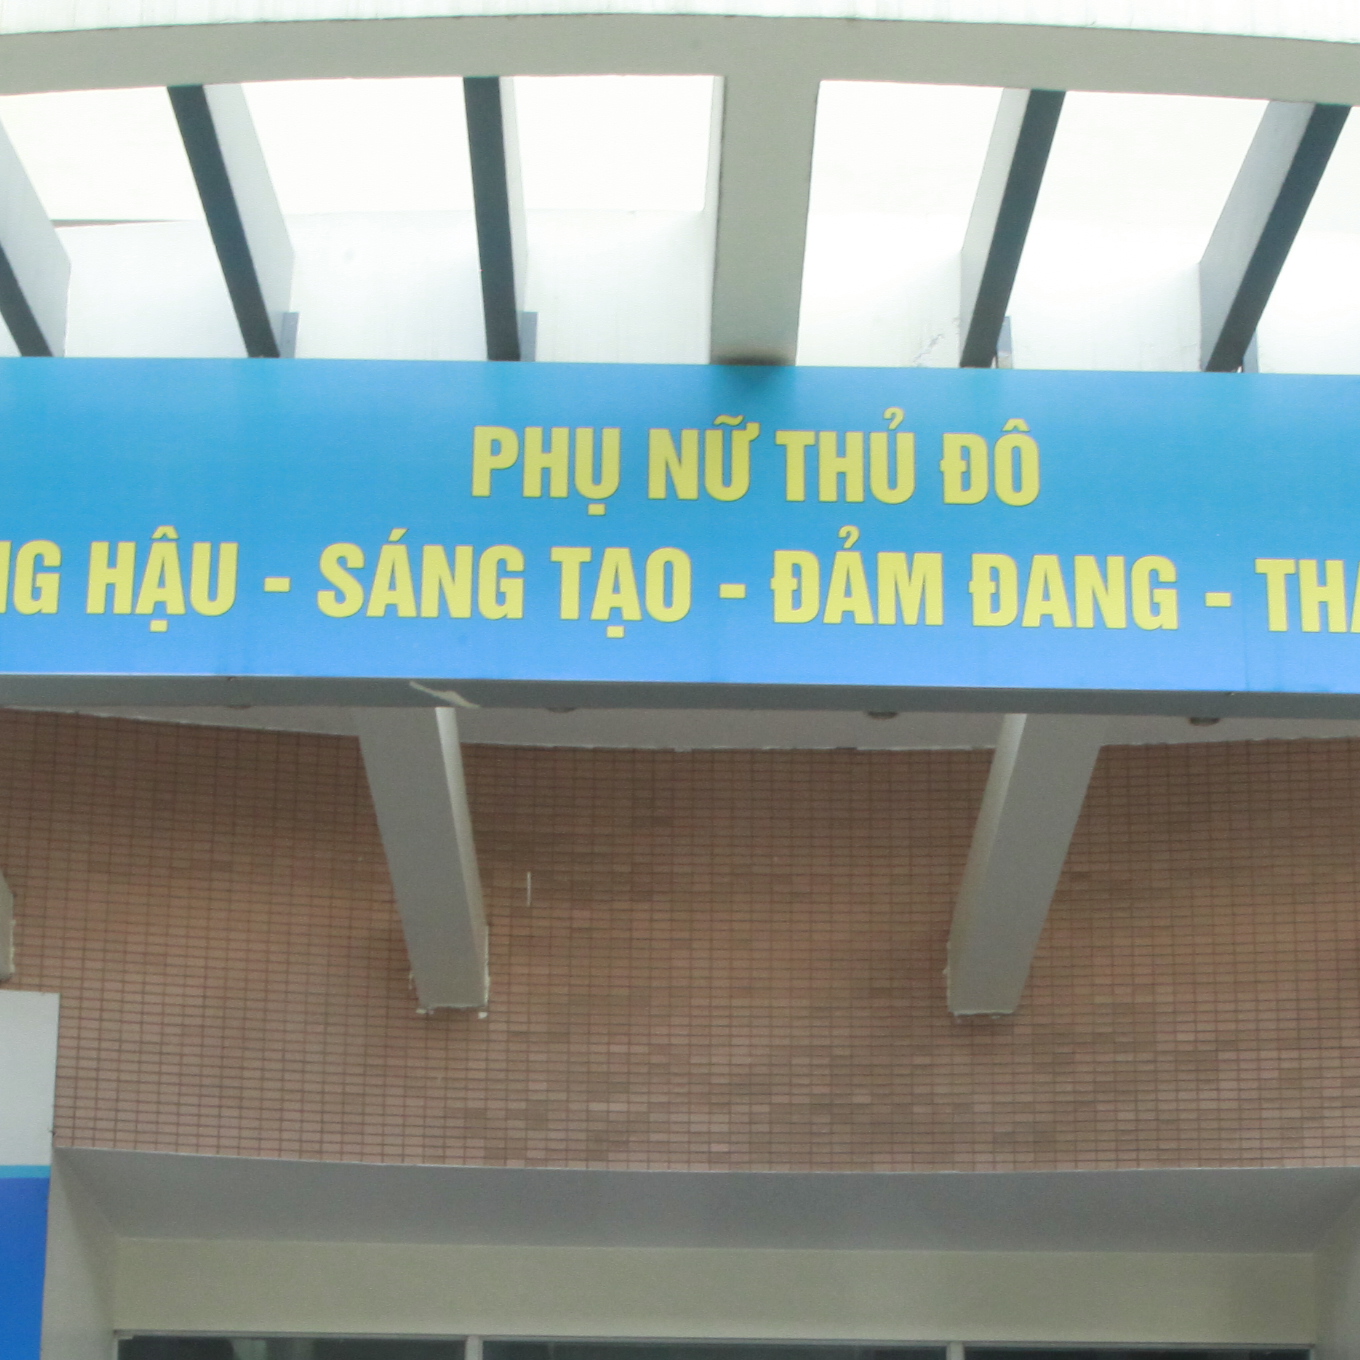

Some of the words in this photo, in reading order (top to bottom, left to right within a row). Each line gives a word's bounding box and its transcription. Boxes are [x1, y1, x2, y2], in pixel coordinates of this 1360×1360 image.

[471, 424, 622, 517] PHỤ
[647, 413, 762, 503] NỮ
[774, 406, 917, 506] THỦ
[939, 417, 1041, 508] ĐÔ
[86, 524, 240, 634] HẬU
[316, 527, 526, 621] SÁNG
[550, 545, 693, 640] TẠO
[769, 524, 945, 627] ĐẢM
[968, 552, 1180, 632] ĐANG
